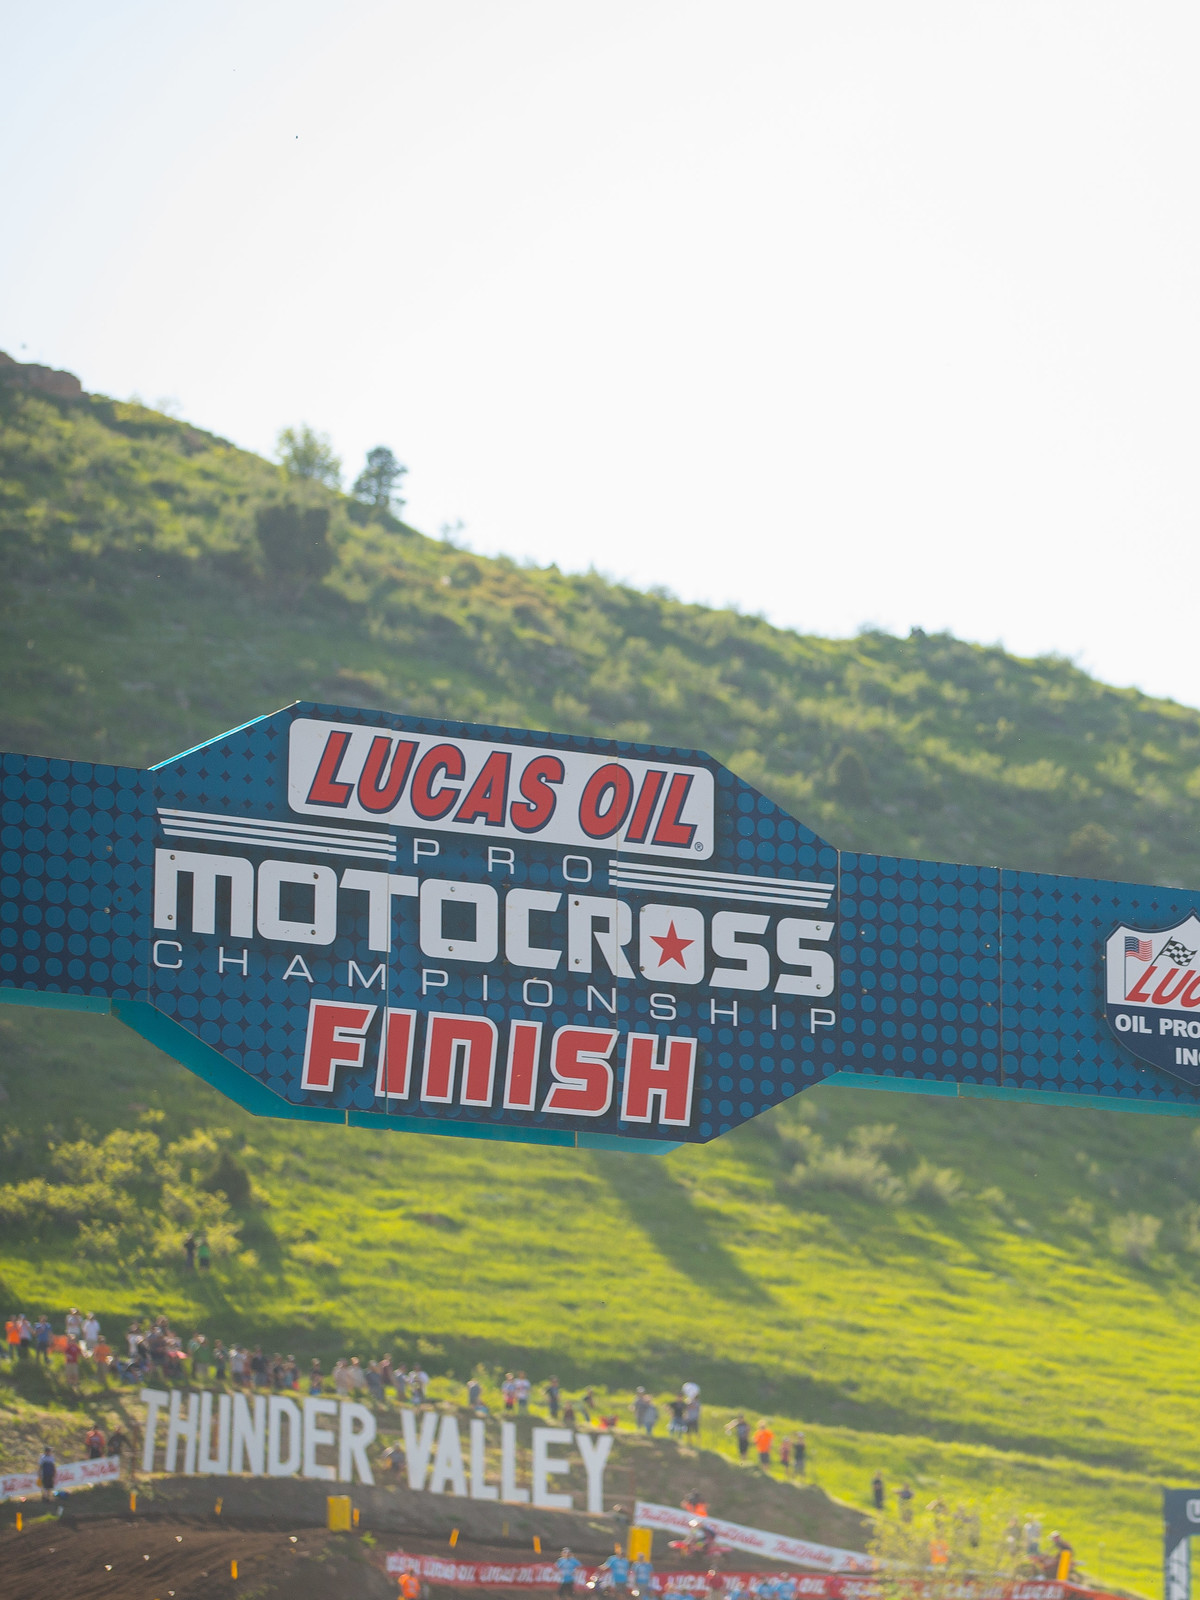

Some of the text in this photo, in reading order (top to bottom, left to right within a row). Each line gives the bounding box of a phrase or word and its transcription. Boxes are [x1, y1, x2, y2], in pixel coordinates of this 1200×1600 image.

[307, 731, 695, 849] LUCAS OIL
[412, 837, 594, 884] PRO
[154, 847, 835, 998] MOTOCROSS
[152, 940, 838, 1034] CHAMPIONSHIP
[1114, 1013, 1152, 1034] OIL
[300, 999, 698, 1127] FINISH
[140, 1387, 614, 1513] THUNDER VALLEY
